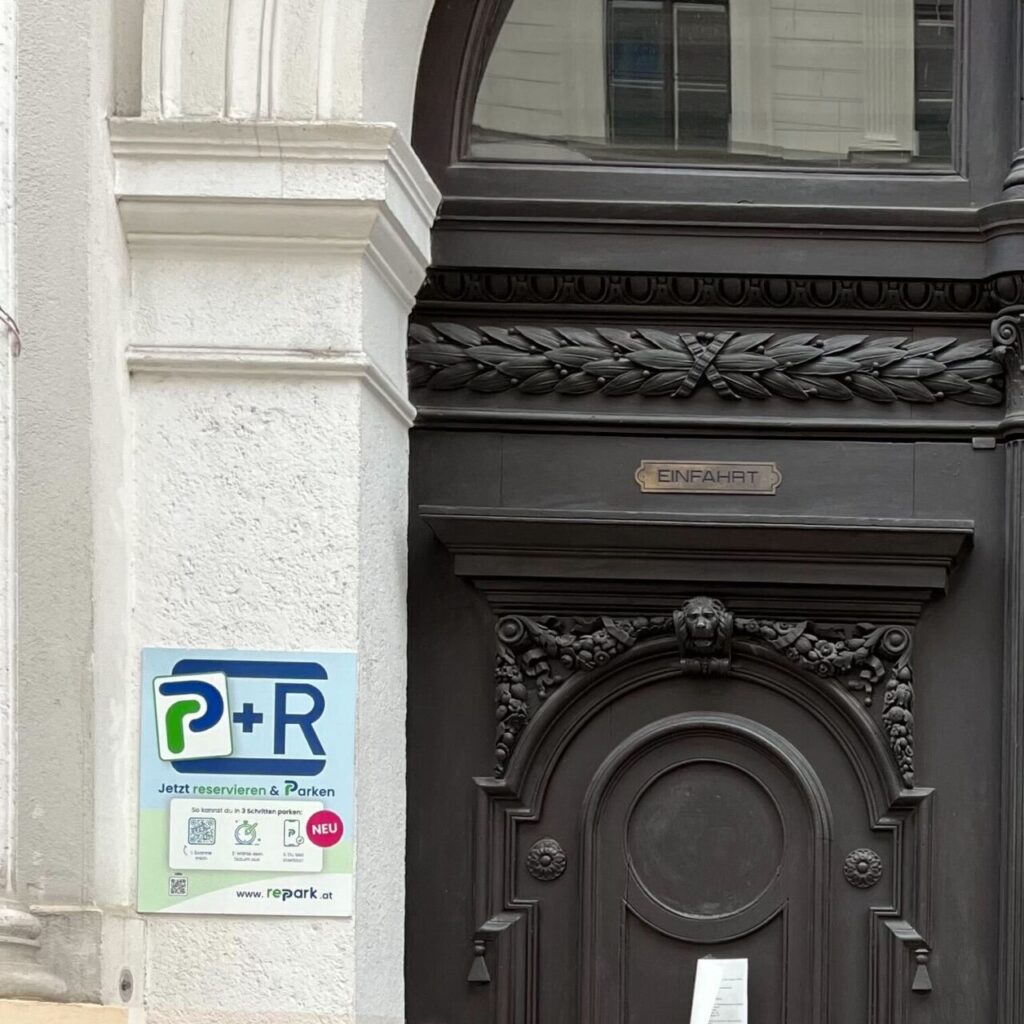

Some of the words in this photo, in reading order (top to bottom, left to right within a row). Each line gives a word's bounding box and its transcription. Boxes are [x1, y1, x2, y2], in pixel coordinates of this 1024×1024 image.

[657, 469, 759, 483] EINFAHRT
[158, 783, 190, 794] Jetzt
[193, 784, 266, 796] reservieren
[270, 786, 279, 796] &
[284, 780, 336, 797] Parken
[312, 823, 338, 835] NEU
